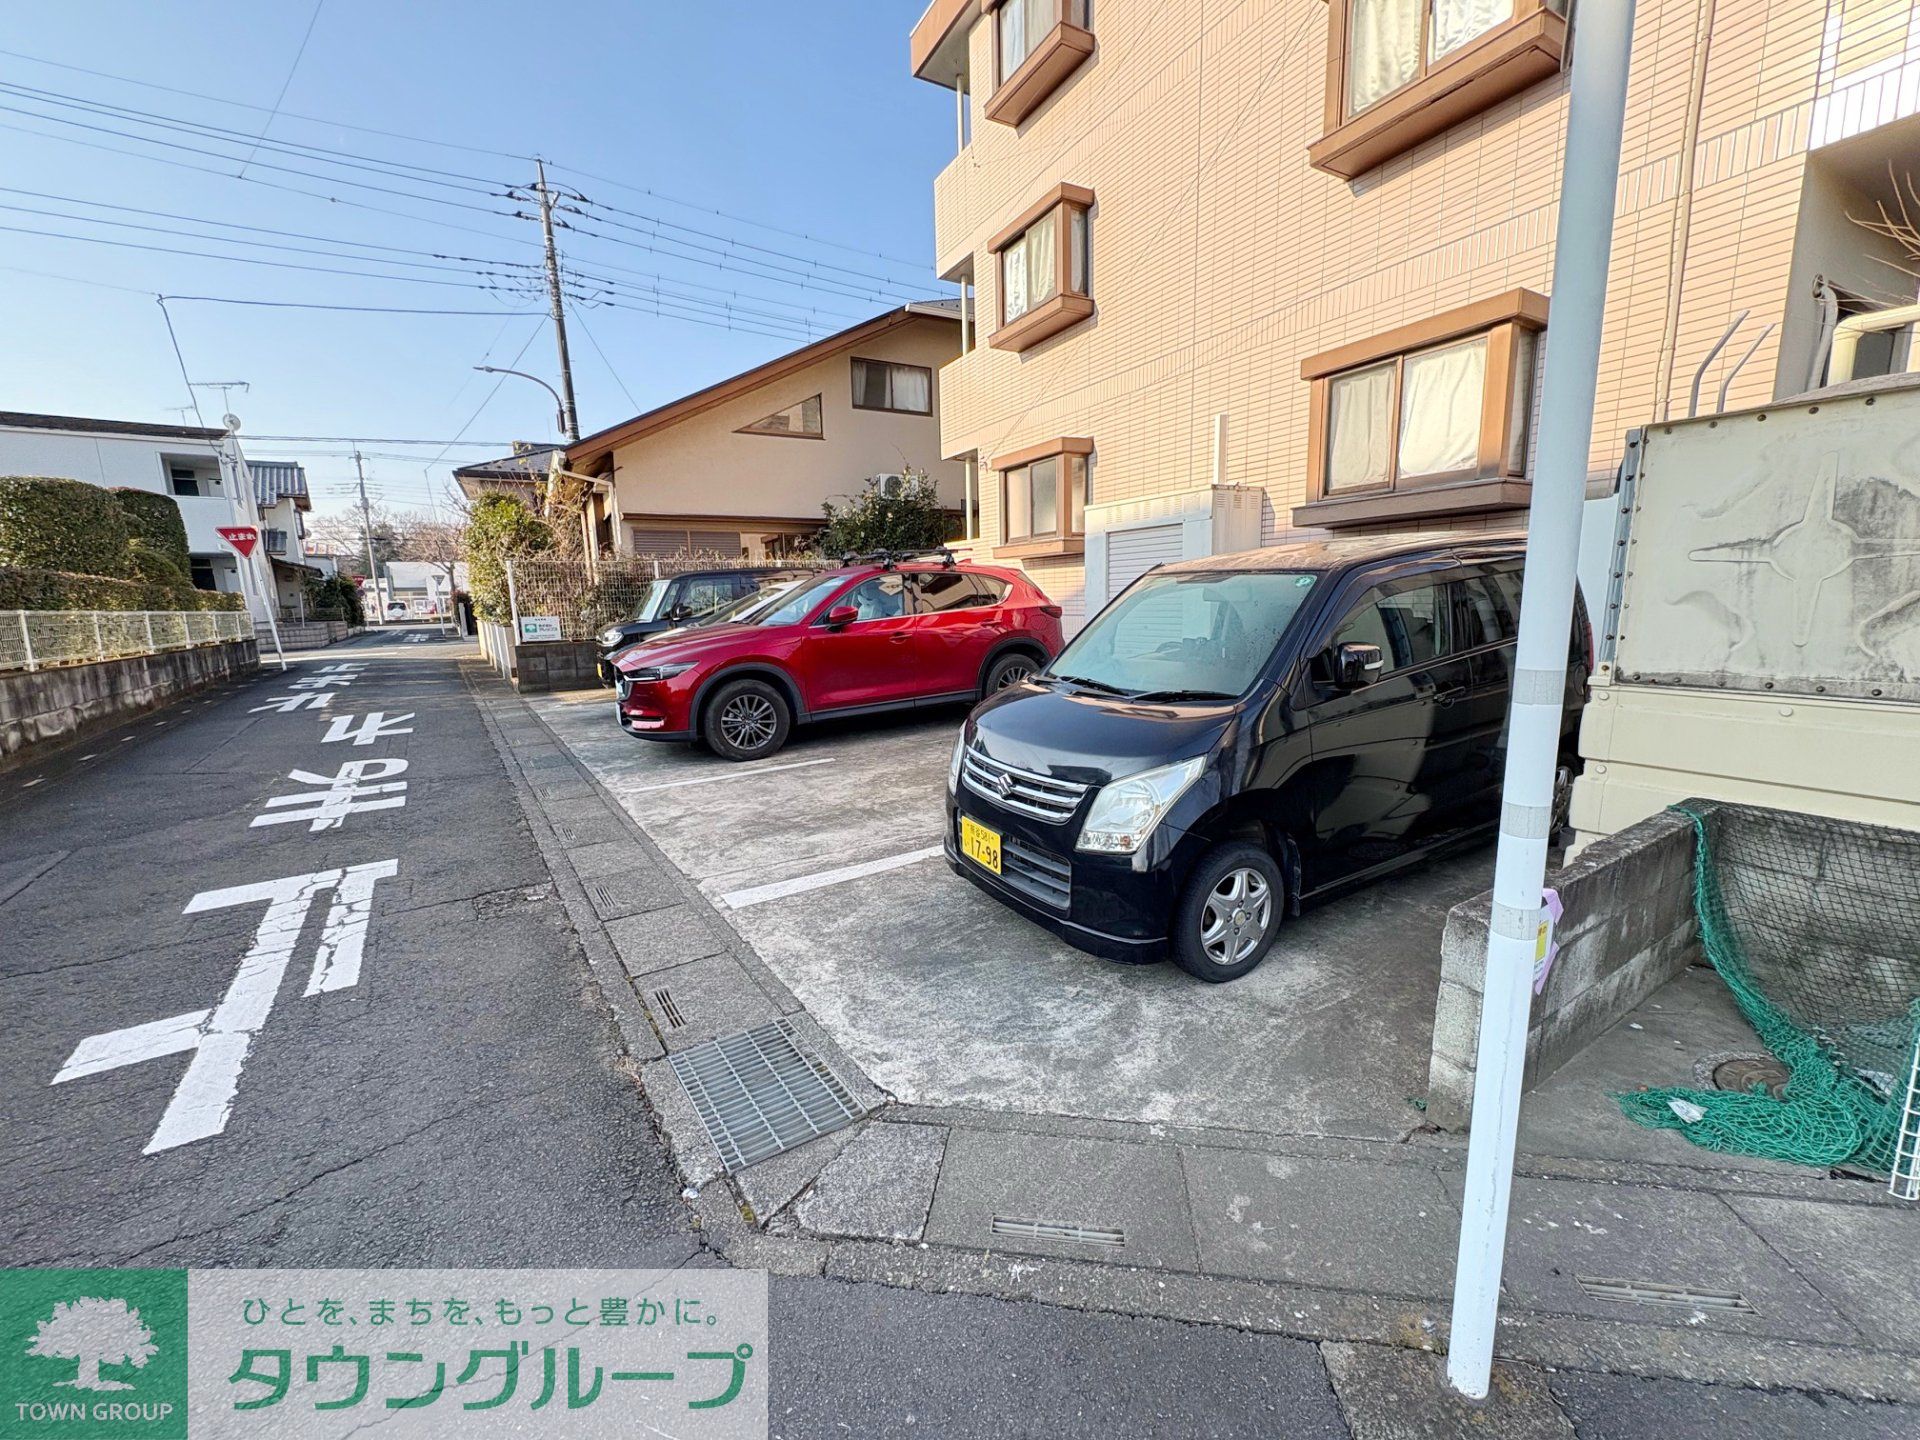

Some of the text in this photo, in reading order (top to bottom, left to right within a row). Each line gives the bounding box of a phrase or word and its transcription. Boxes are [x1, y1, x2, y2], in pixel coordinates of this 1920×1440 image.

[247, 663, 370, 713] 止まれ
[971, 836, 998, 869] 17-98
[50, 712, 416, 1155] 止まれ
